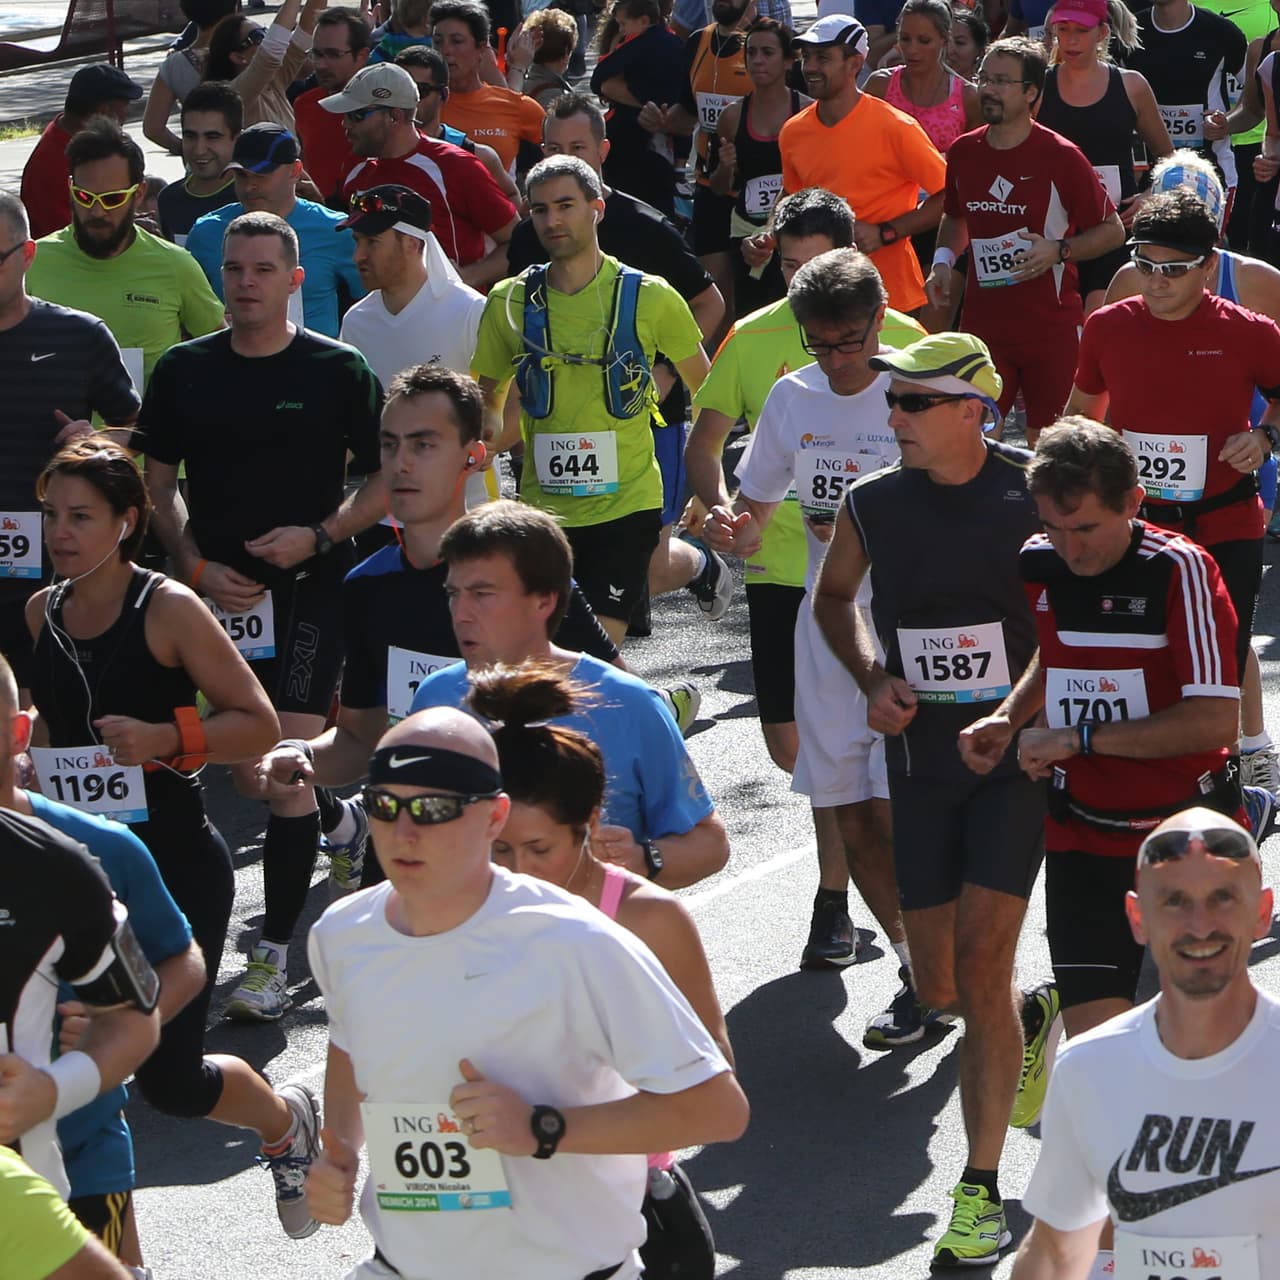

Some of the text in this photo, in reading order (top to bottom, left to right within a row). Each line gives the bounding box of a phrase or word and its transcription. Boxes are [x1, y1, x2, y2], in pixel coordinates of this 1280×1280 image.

[758, 178, 778, 188] ING
[966, 201, 1027, 215] SPORTCITY
[982, 244, 1000, 254] ING
[551, 440, 576, 451] ING
[1139, 440, 1165, 454] ING
[549, 453, 600, 478] 644
[815, 458, 842, 472] ING
[1138, 455, 1186, 481] 292
[921, 636, 954, 651] ING
[915, 651, 992, 682] 1587
[1066, 678, 1095, 693] ING
[938, 691, 956, 701] 2014
[55, 756, 89, 770] ING
[49, 771, 129, 802] 1196
[392, 1116, 434, 1133] ING
[1125, 1113, 1256, 1179] RUN
[394, 1141, 472, 1179] 603
[405, 1182, 471, 1191] VIRION Nicolas
[414, 1195, 437, 1208] 2014
[1142, 1248, 1186, 1269] ING
